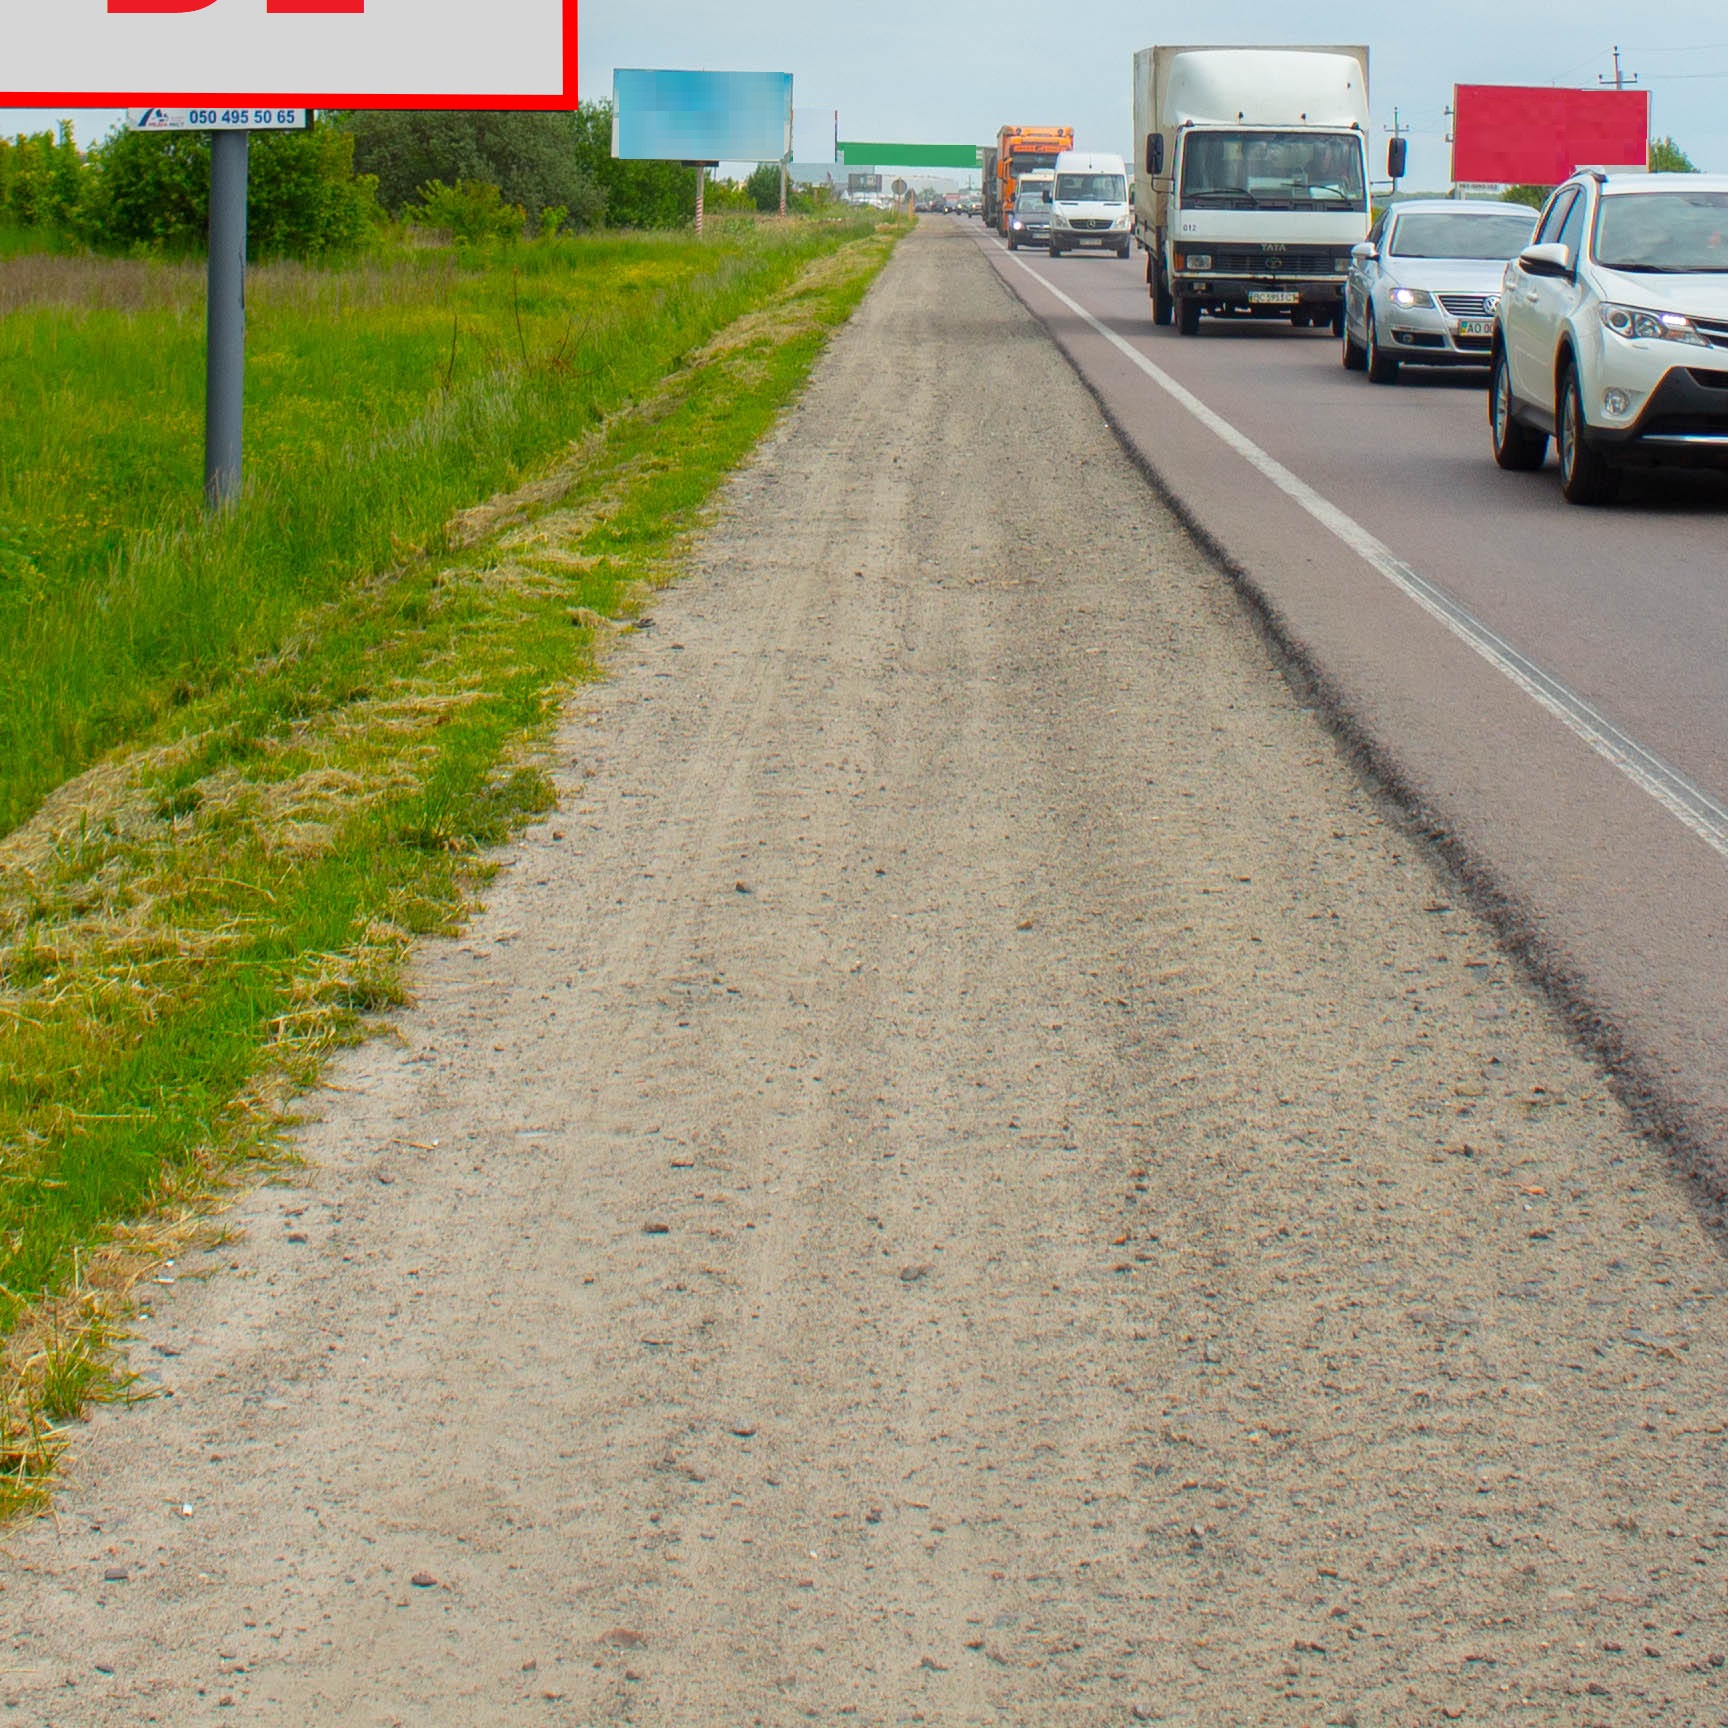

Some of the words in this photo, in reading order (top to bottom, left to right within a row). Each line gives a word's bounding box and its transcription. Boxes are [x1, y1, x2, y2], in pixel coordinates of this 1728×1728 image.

[189, 110, 217, 124] 050
[220, 110, 249, 124] 495
[254, 110, 272, 124] 50
[277, 110, 295, 124] 65
[1261, 243, 1287, 252] TATA
